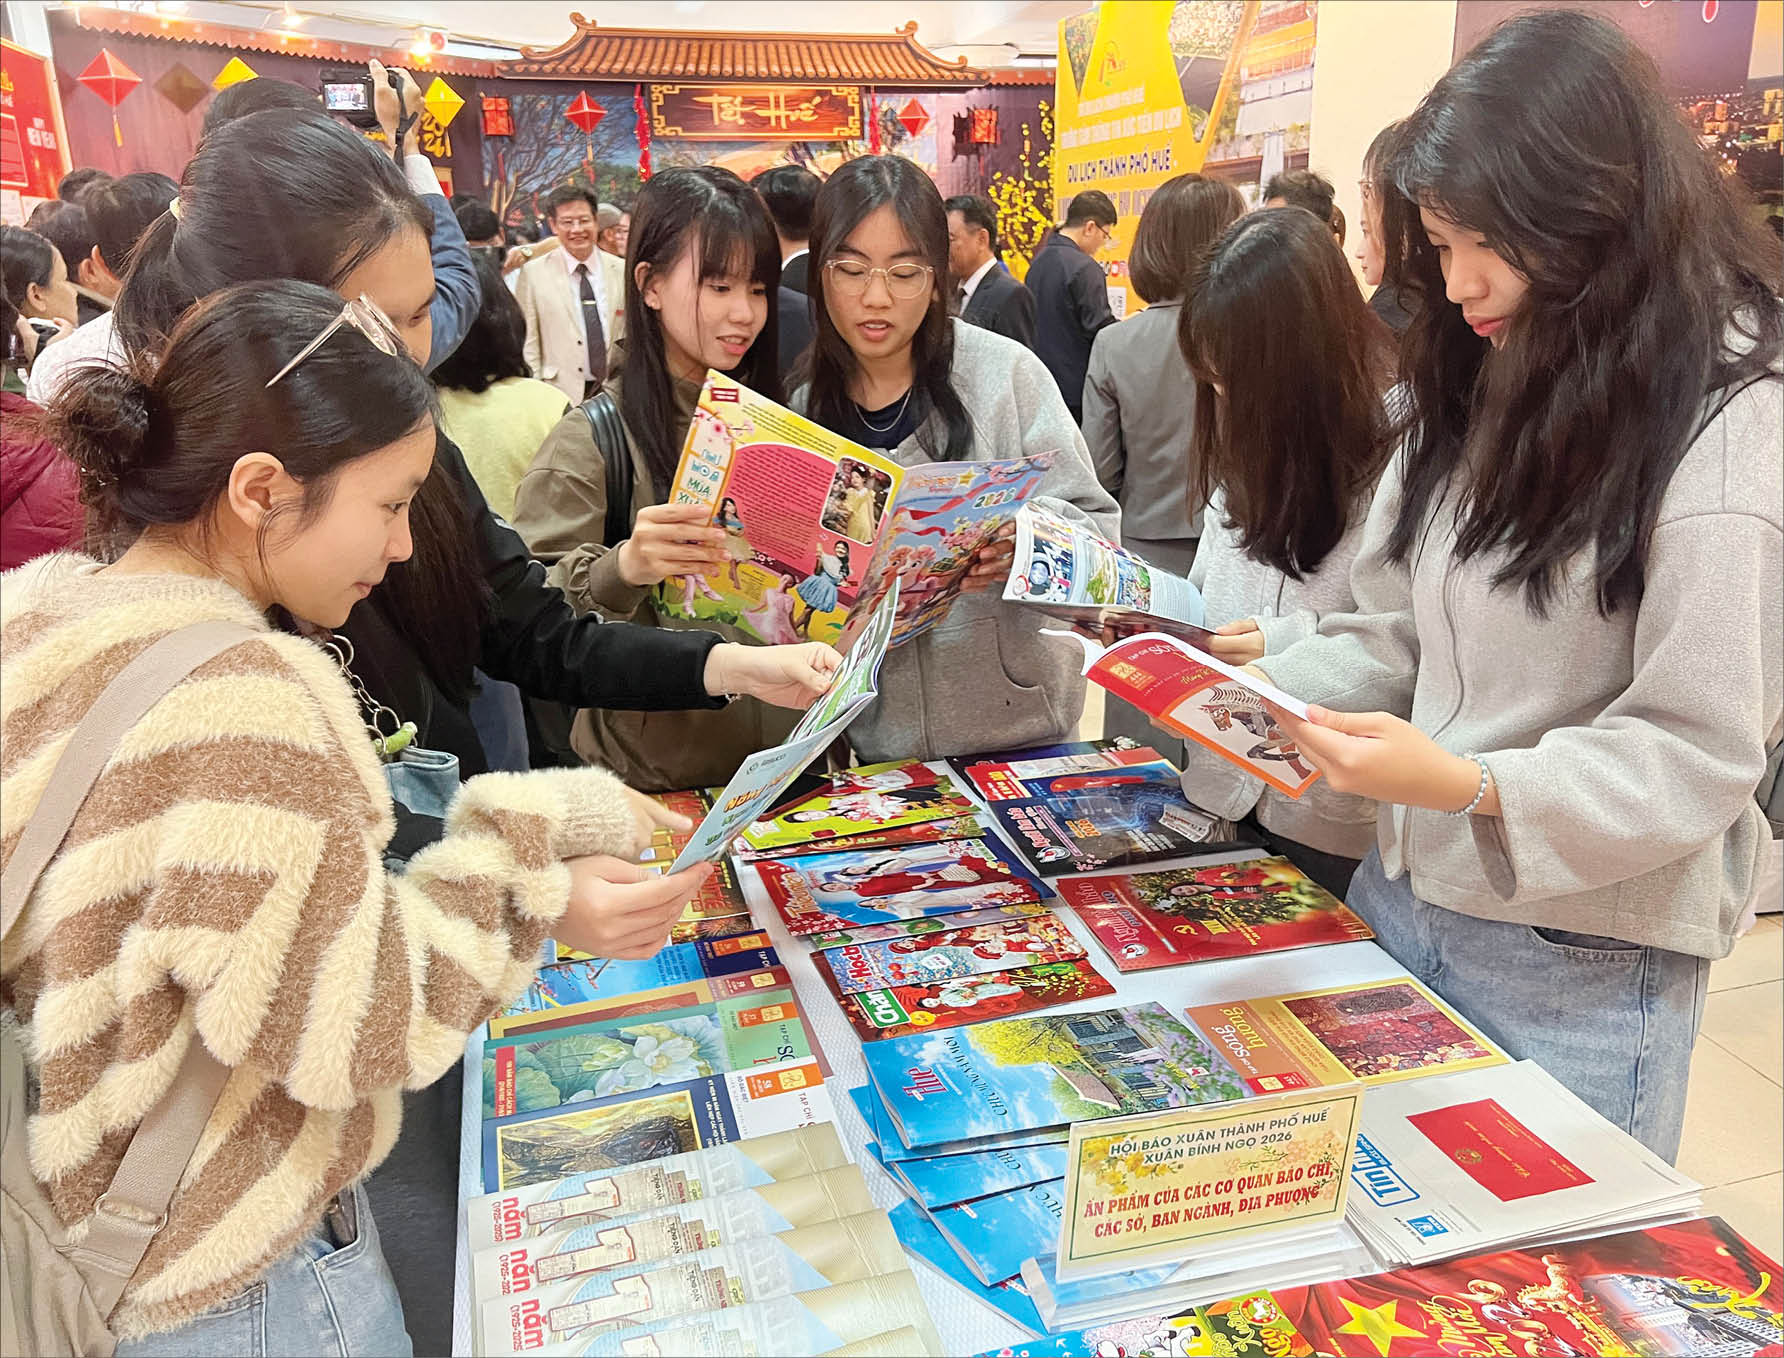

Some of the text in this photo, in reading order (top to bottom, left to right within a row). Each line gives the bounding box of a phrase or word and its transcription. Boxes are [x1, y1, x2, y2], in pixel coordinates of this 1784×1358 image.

[1129, 142, 1149, 174] PHỐ
[1111, 1107, 1330, 1156] HỘI BÁO XUÂN THÀNH PHỐ HUẾ
[1143, 1131, 1293, 1165] XUÂN BÍNH NGỌ 2026
[1084, 1160, 1335, 1219] ẤN PHẨM CỦA CÁC CƠ QUAN BÁO CHÍ,
[1363, 1169, 1401, 1198] Tin
[499, 1196, 521, 1242] năm
[1094, 1183, 1322, 1239] CÁC SỞ, BAN NGÀNH, ĐỊA PHƯƠNG
[520, 1298, 544, 1349] năm
